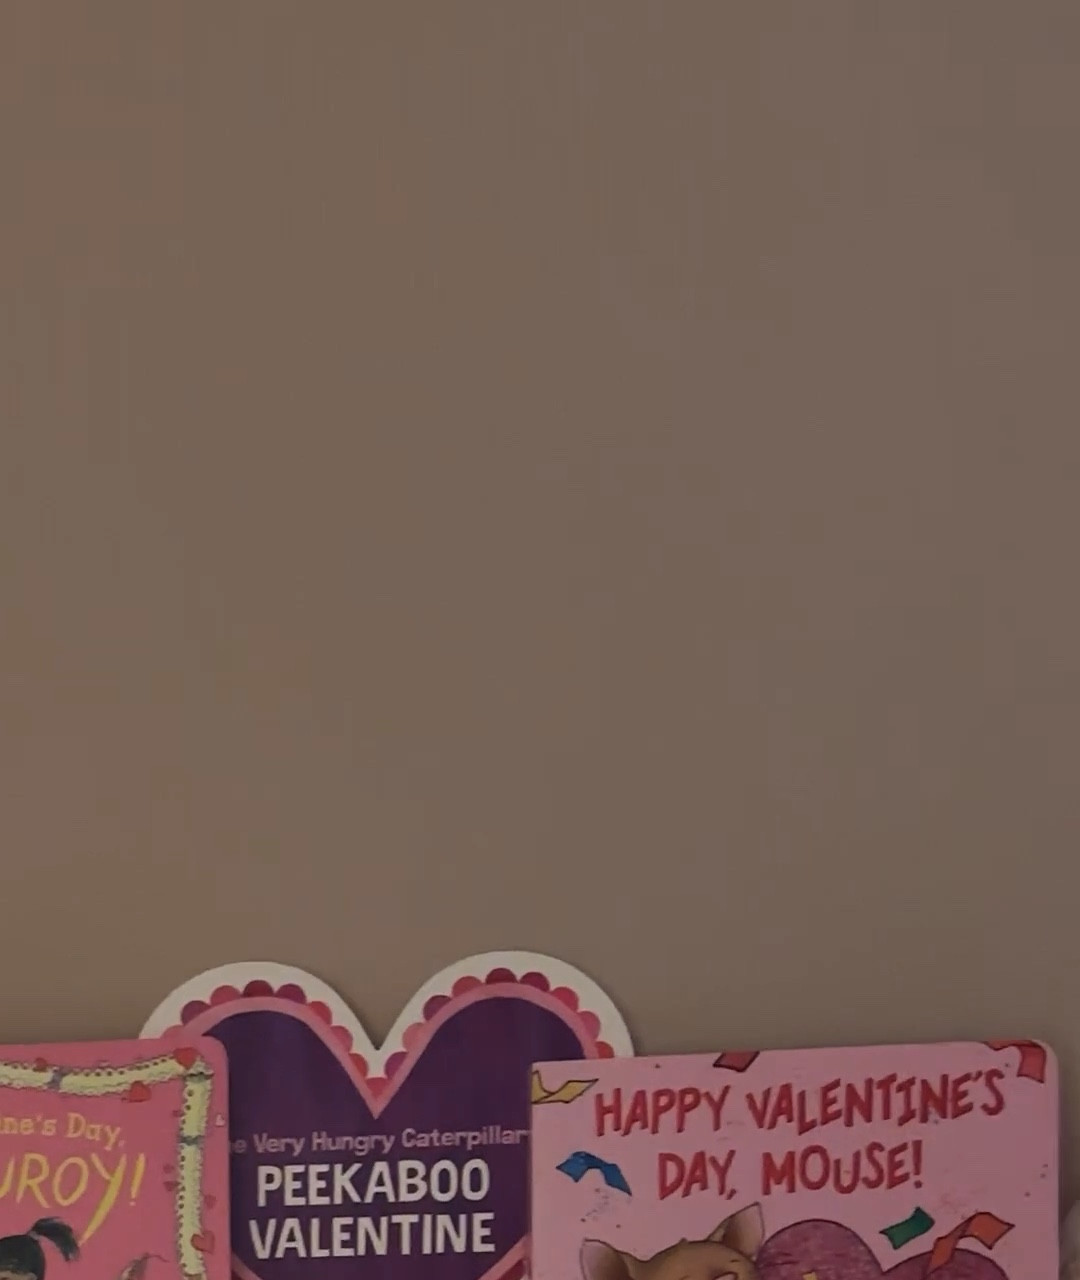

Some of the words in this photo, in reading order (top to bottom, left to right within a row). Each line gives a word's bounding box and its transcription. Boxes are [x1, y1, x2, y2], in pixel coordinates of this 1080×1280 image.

[593, 1084, 731, 1138] HAPPY
[745, 1067, 1007, 1135] VALENTINE'S
[253, 1132, 306, 1157] Very
[311, 1130, 396, 1157] Hungry
[256, 1157, 491, 1207] PEEKABOO
[657, 1148, 737, 1200] DAY,
[761, 1138, 924, 1196] MOUSE!
[249, 1211, 497, 1261] VALENTINE
